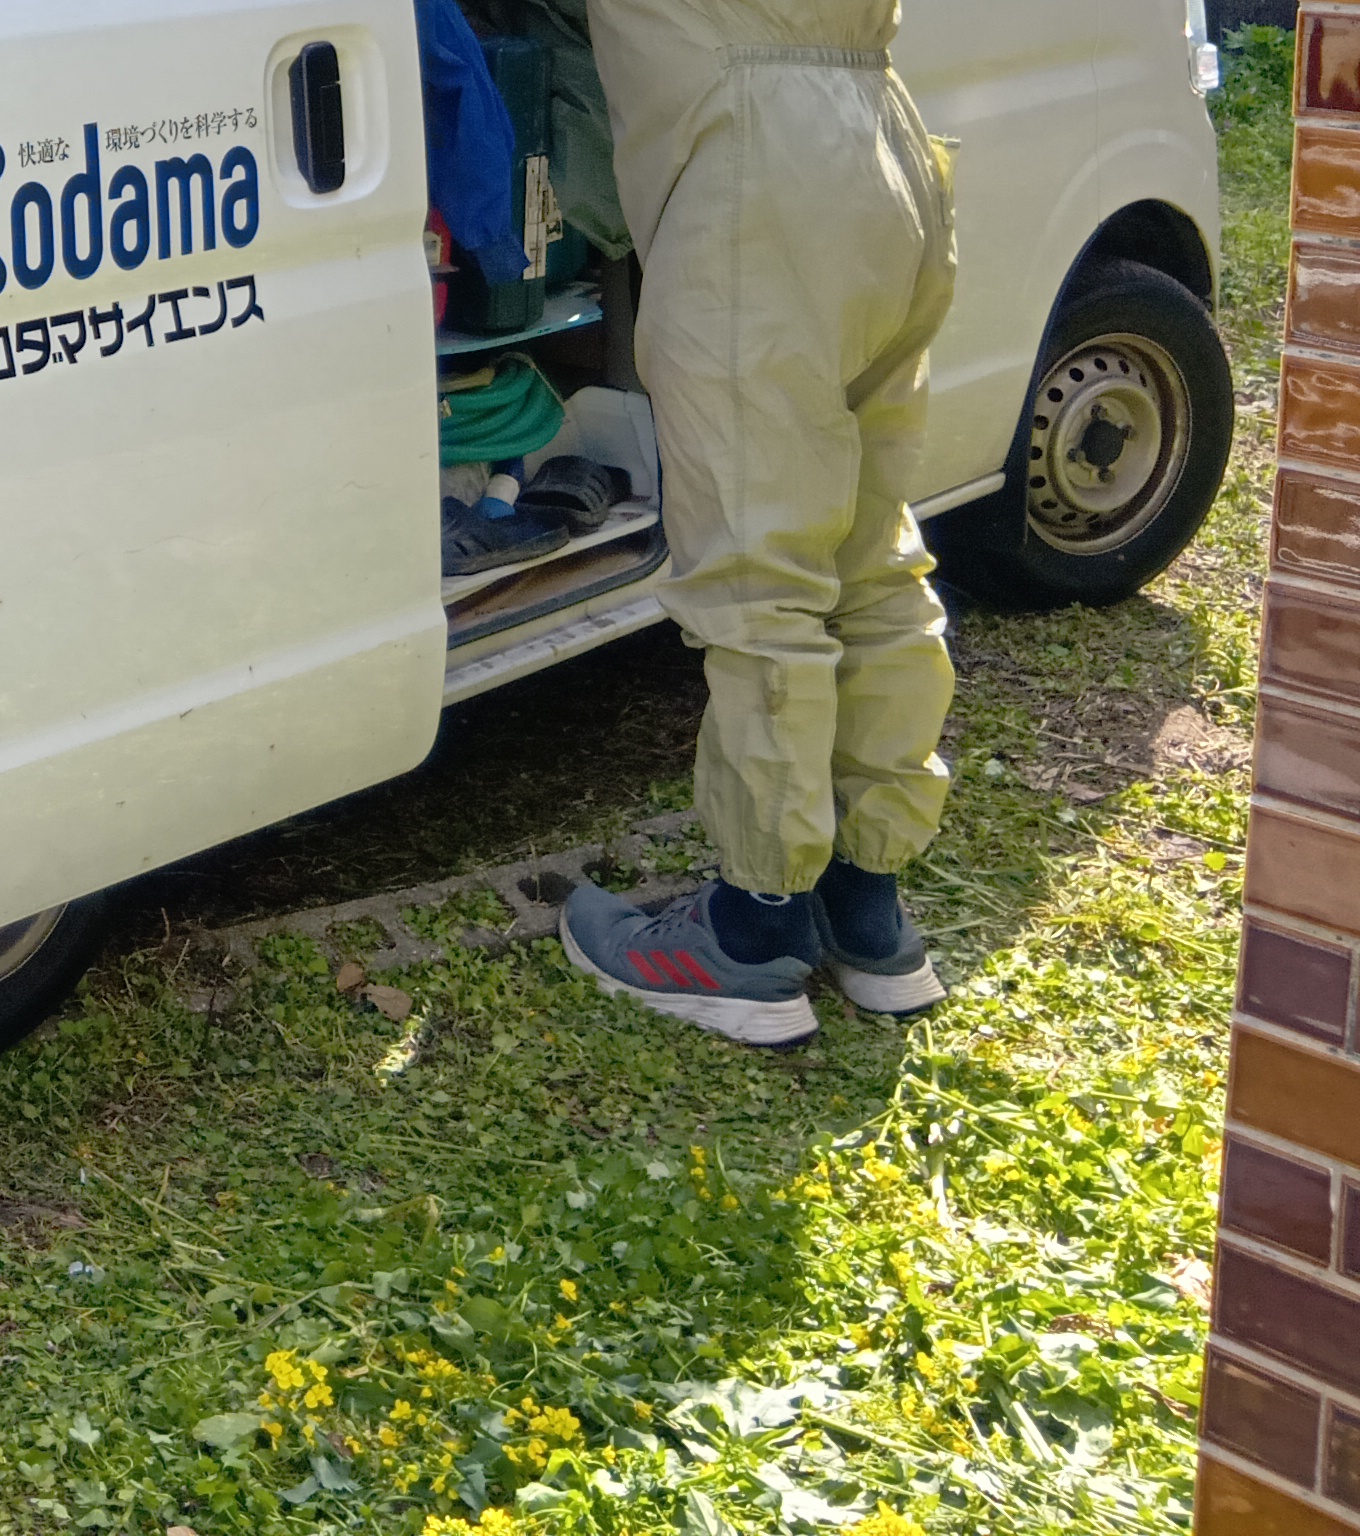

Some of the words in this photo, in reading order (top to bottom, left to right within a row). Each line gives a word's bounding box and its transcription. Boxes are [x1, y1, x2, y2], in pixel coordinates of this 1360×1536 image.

[18, 137, 70, 168] 快適な
[105, 108, 258, 152] 環境づくりを科学する
